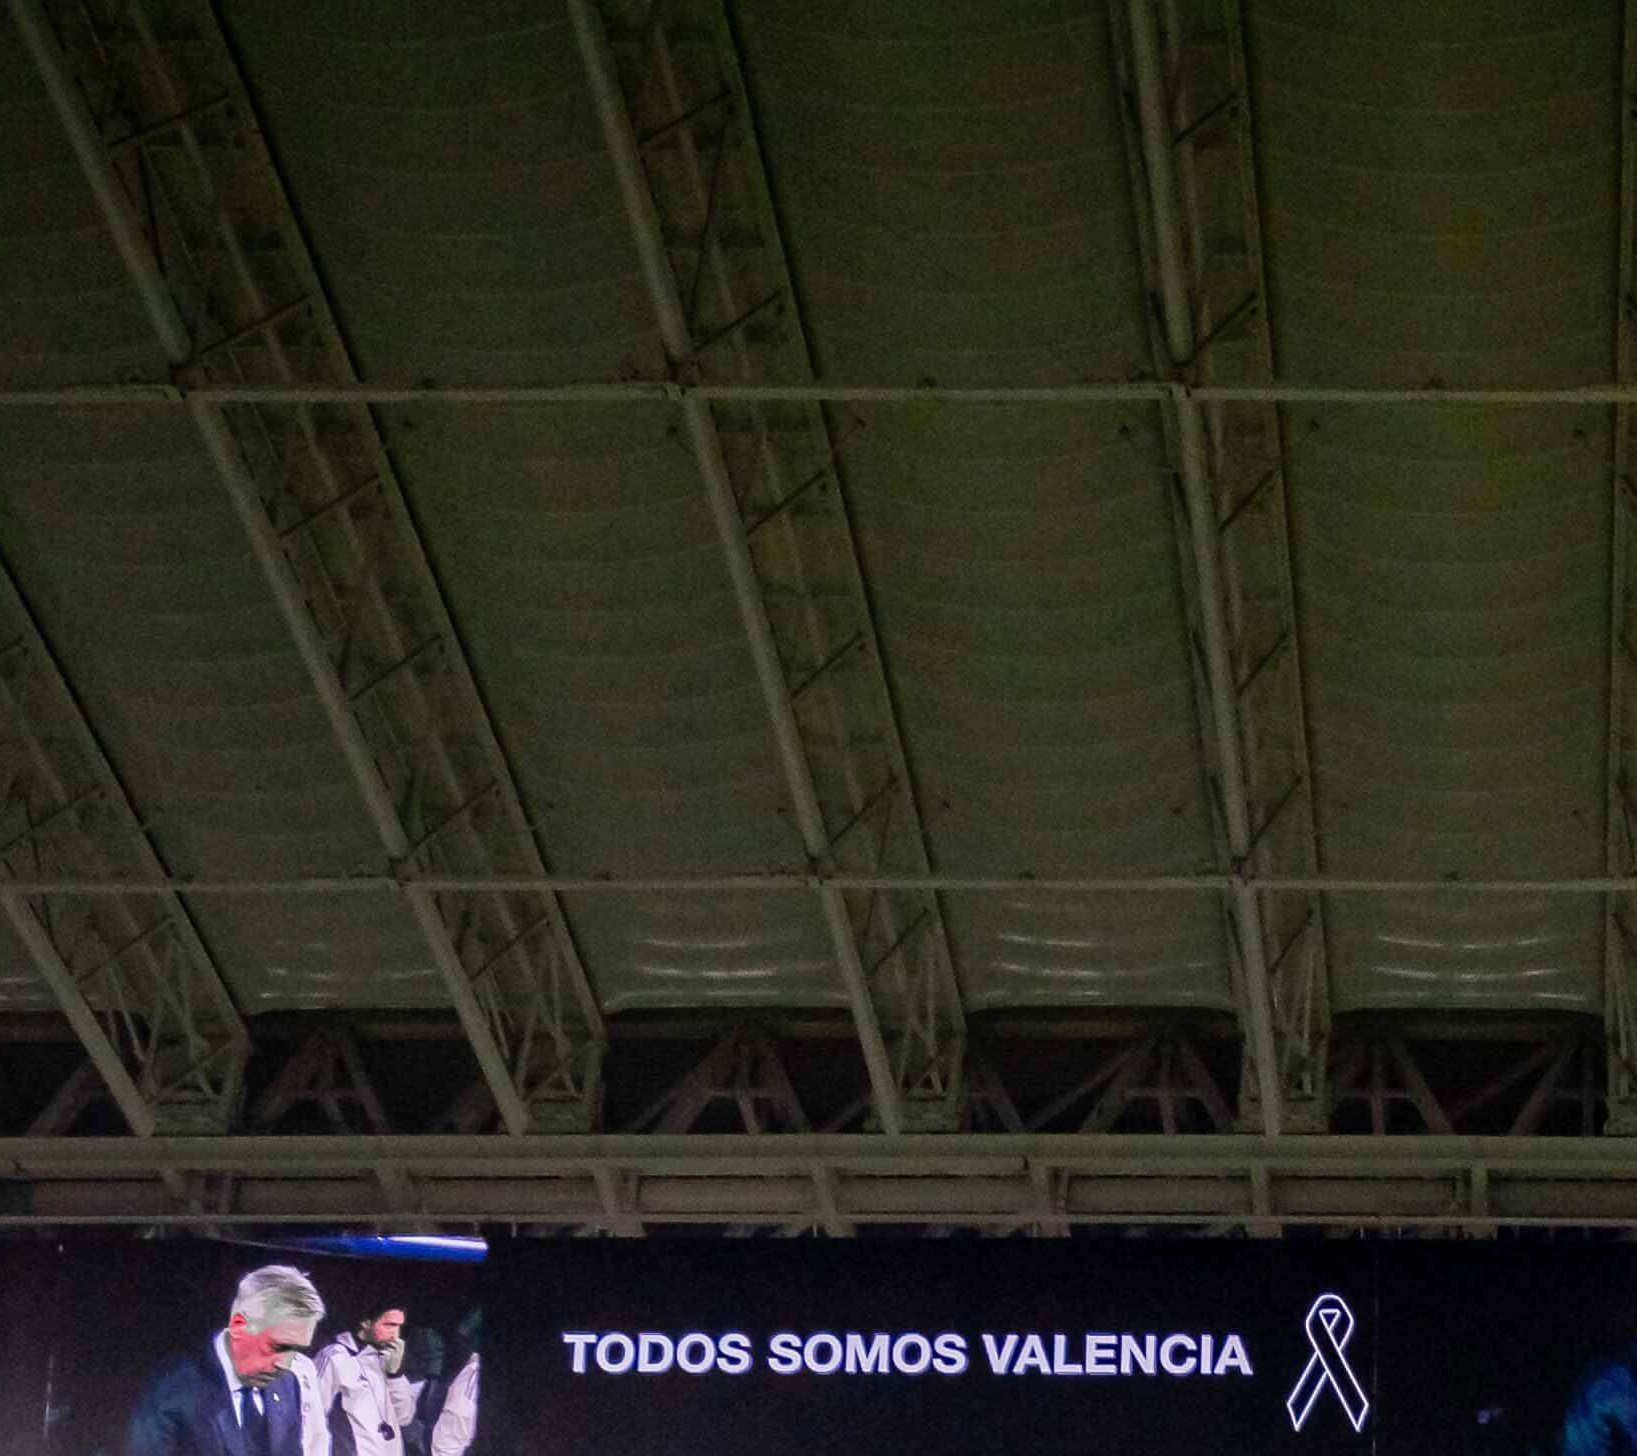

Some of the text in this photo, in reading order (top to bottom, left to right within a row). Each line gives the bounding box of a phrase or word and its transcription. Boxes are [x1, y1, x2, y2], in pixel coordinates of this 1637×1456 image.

[562, 1332, 1255, 1376] TODOS SOMOS VALENCIA
